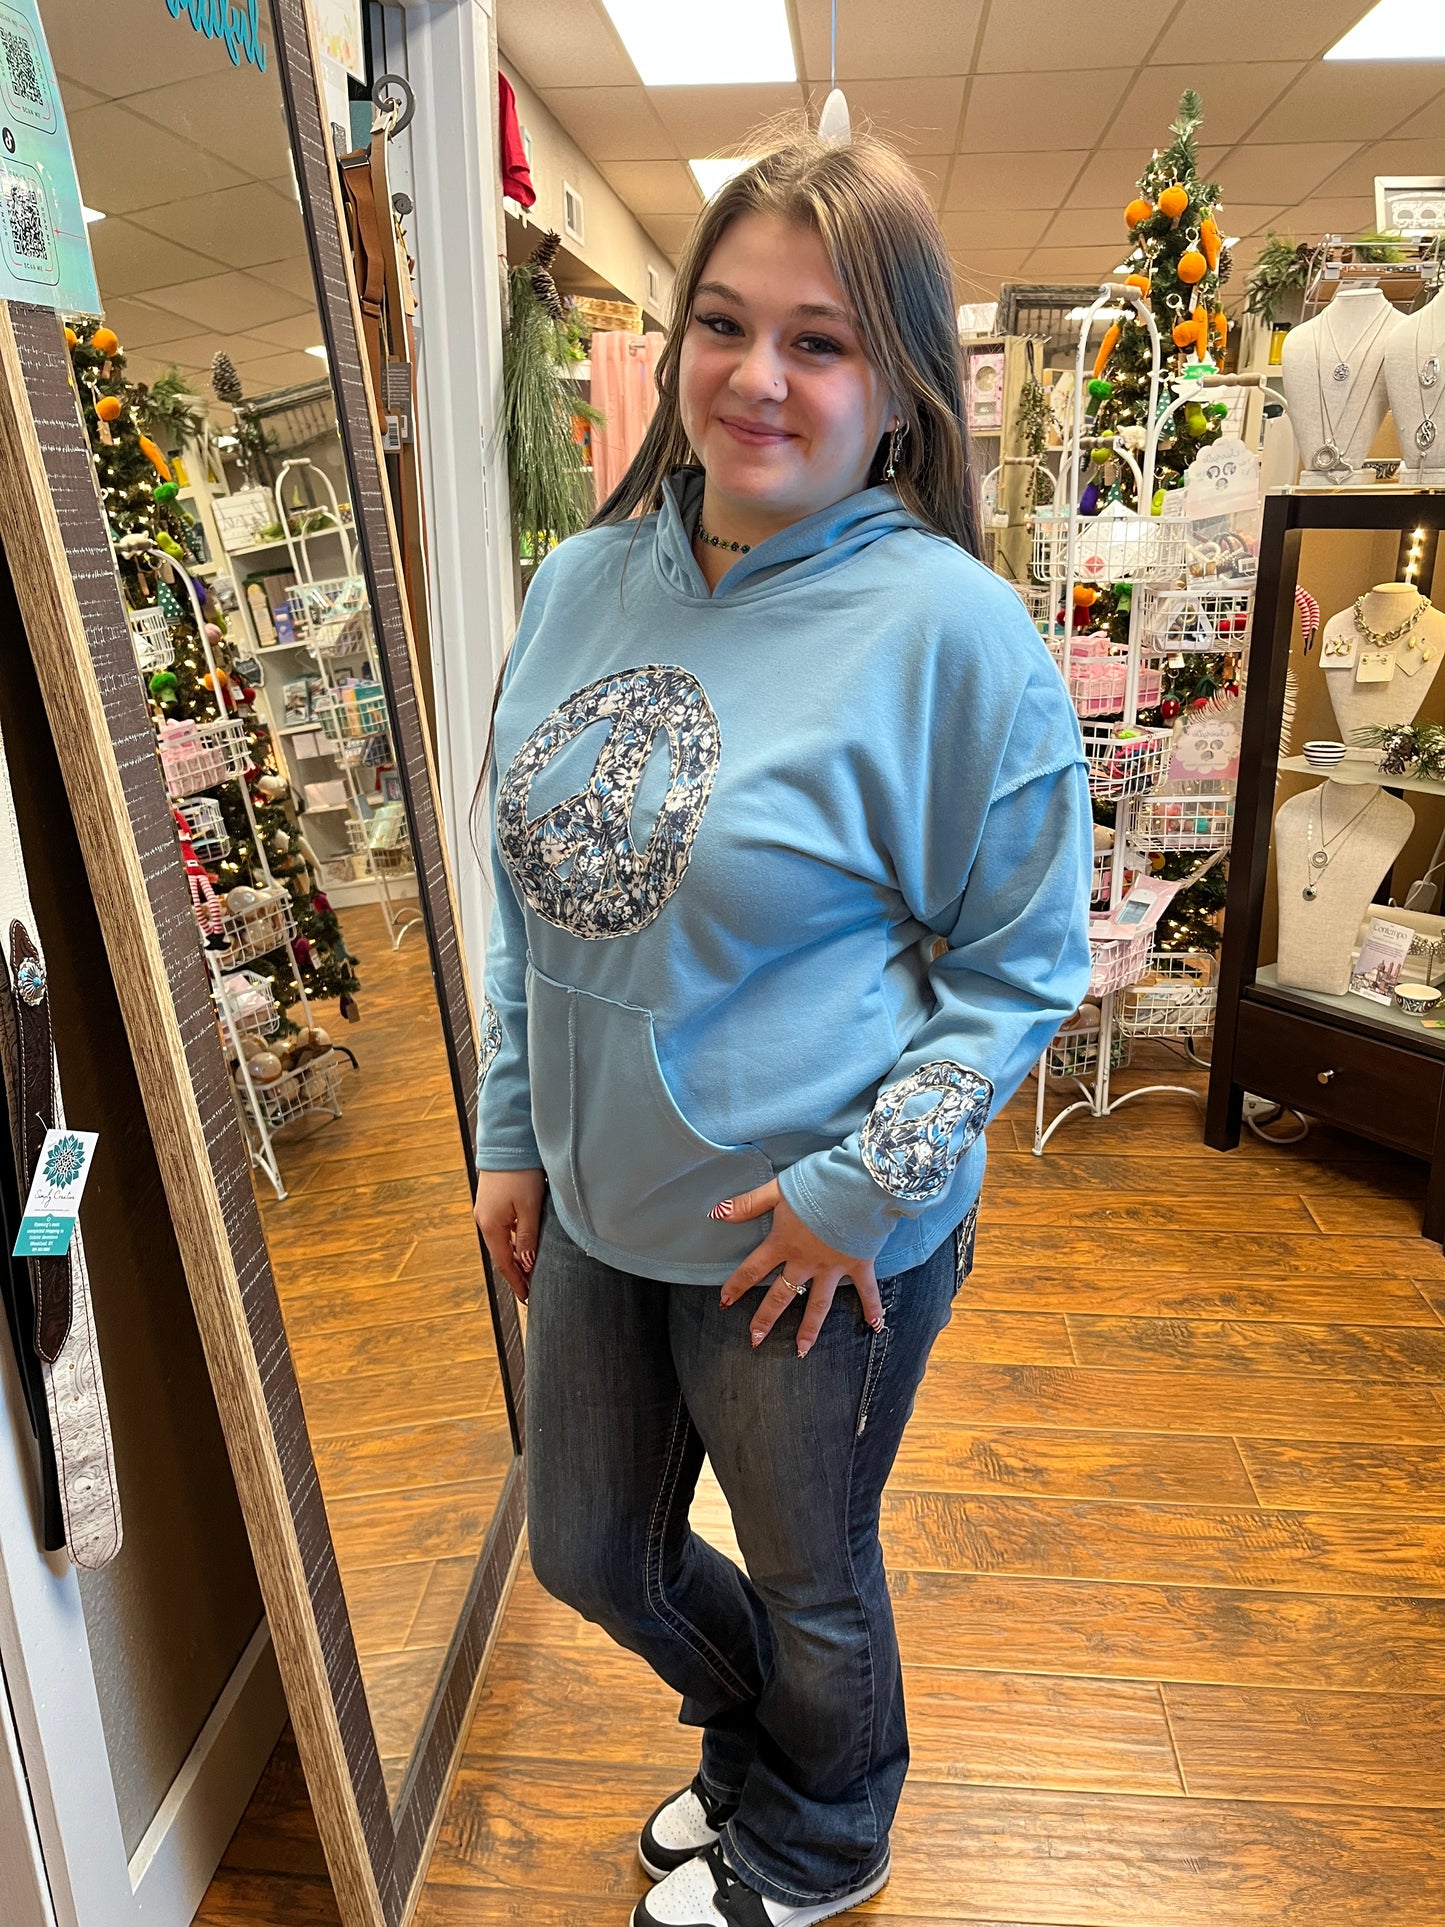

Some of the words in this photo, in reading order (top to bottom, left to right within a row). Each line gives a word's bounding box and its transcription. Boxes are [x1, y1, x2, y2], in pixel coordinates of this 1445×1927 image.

[22, 106, 35, 115] SCAN
[23, 262, 36, 270] SCAN
[1373, 923, 1408, 940] Contempo
[34, 1189, 54, 1208] Simply
